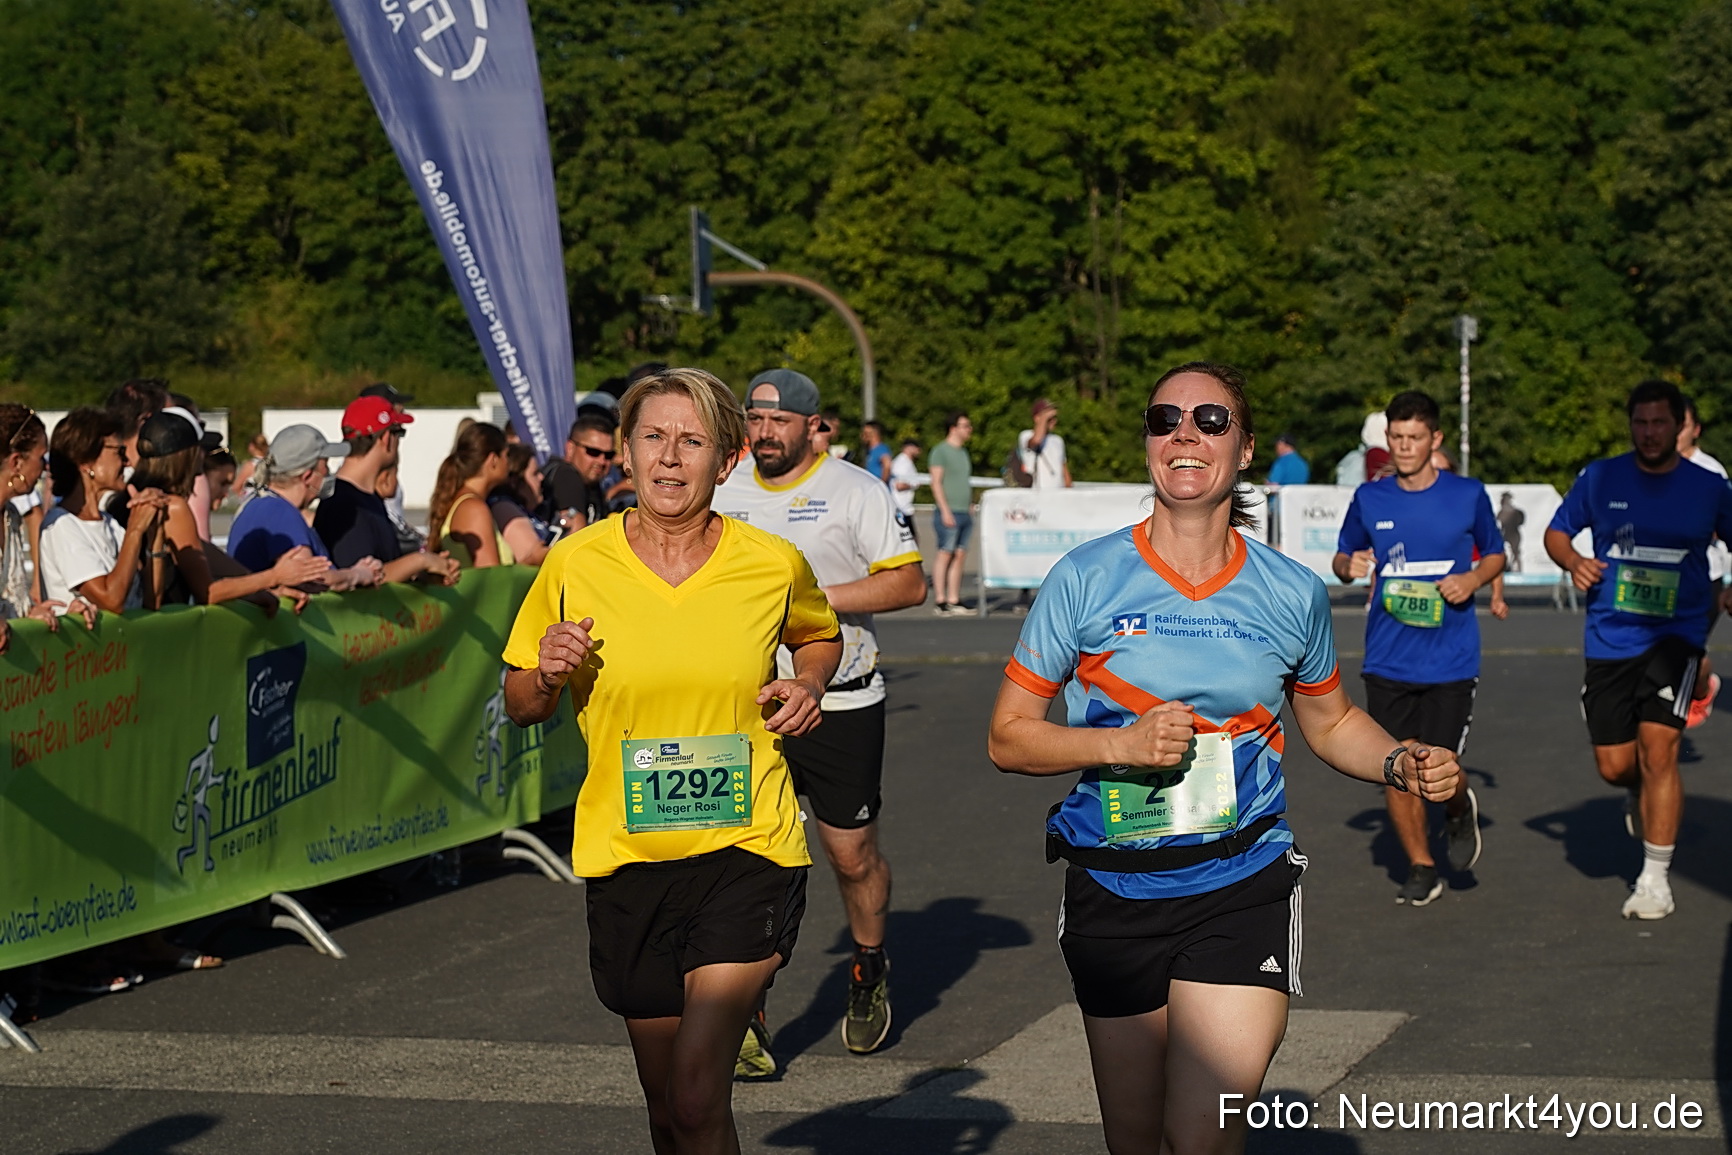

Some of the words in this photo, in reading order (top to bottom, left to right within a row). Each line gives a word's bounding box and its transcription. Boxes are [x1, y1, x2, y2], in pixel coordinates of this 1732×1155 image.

[1398, 595, 1429, 612] 788
[1631, 584, 1661, 599] 791
[1154, 614, 1238, 629] Raiffeisenbank
[1154, 625, 1213, 639] Neumarkt
[64, 641, 127, 689] Firmen
[10, 707, 70, 770] laufen
[72, 674, 142, 750] länger!
[221, 715, 341, 831] firmenlauf
[655, 752, 694, 763] Firmenlauf
[631, 781, 645, 814] RUN
[646, 767, 730, 800] 1292
[732, 771, 746, 814] 2022
[657, 804, 692, 816] Neger
[695, 801, 721, 812] Rosi
[1109, 789, 1122, 823] RUN
[1121, 807, 1167, 821] Semmler
[221, 817, 279, 860] neumarkt
